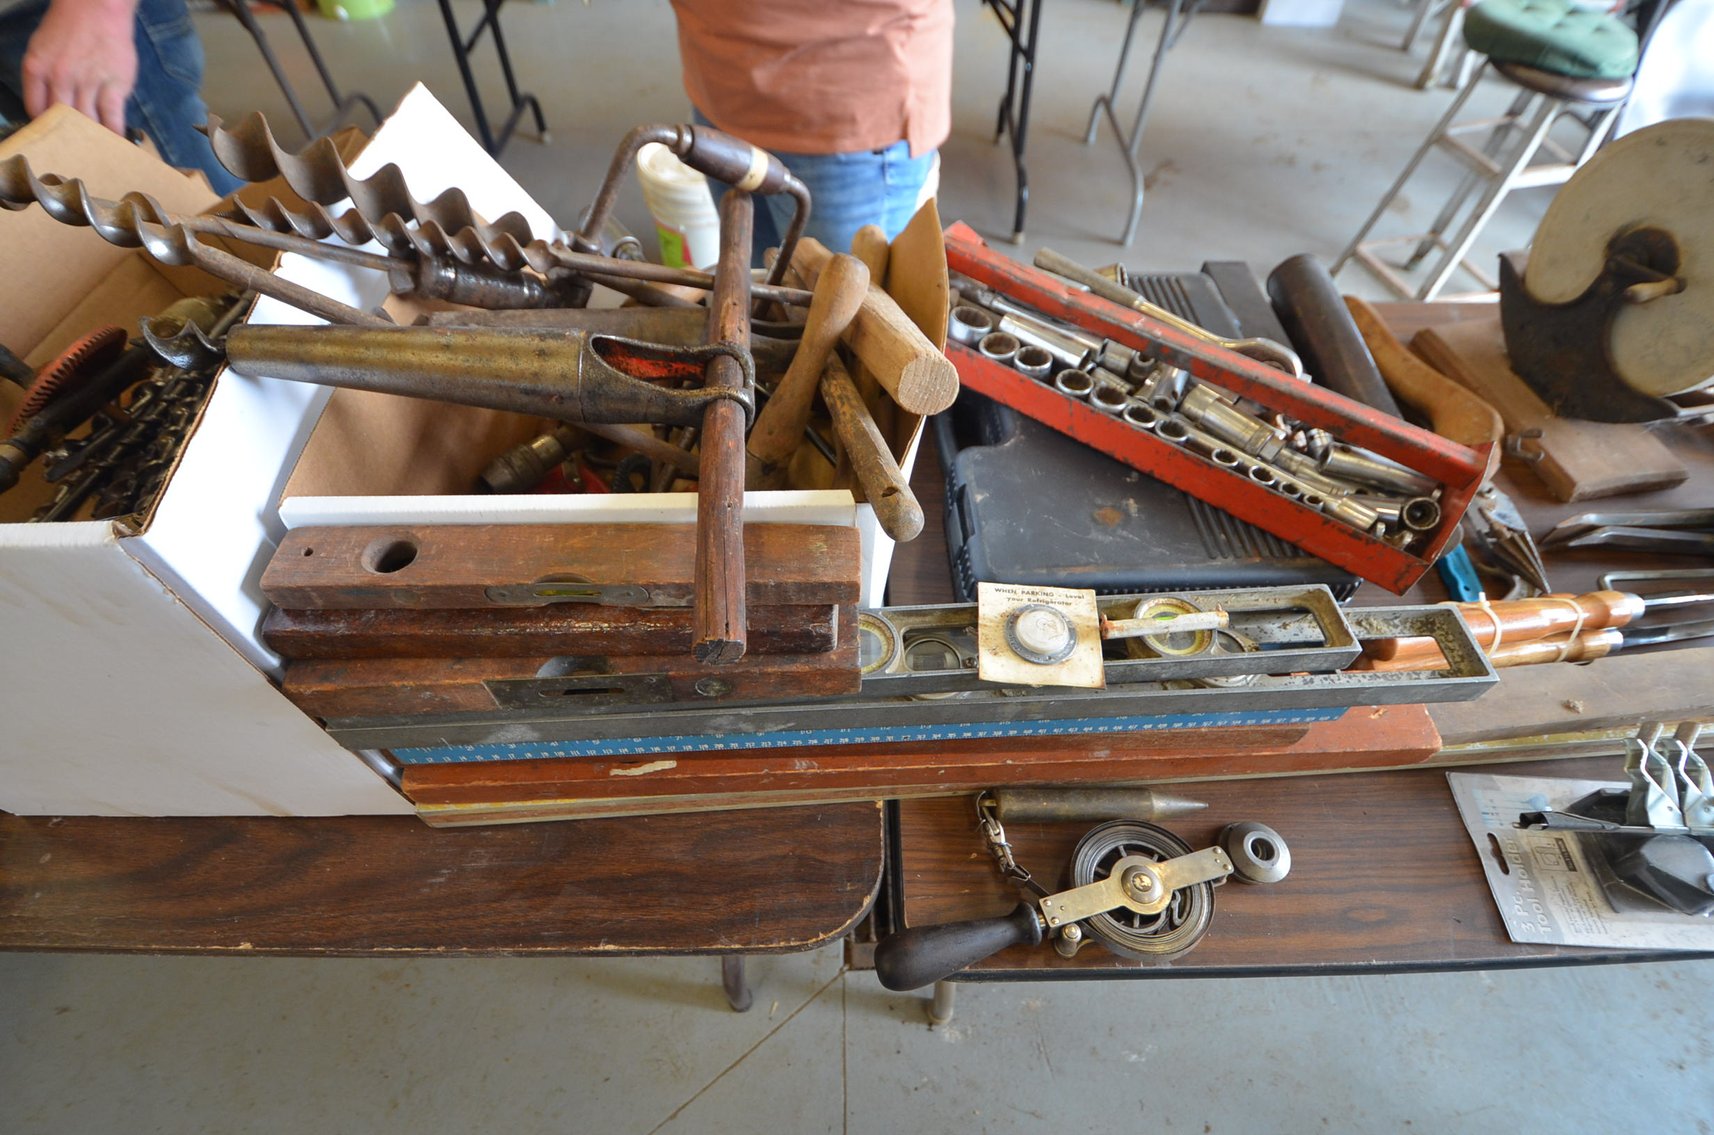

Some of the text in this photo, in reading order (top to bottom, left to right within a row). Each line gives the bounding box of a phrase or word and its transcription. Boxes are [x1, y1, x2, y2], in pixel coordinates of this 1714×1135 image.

[994, 587, 1017, 595] WHEN
[1504, 837, 1553, 936] Tool Holder
[1521, 922, 1536, 935] 3
